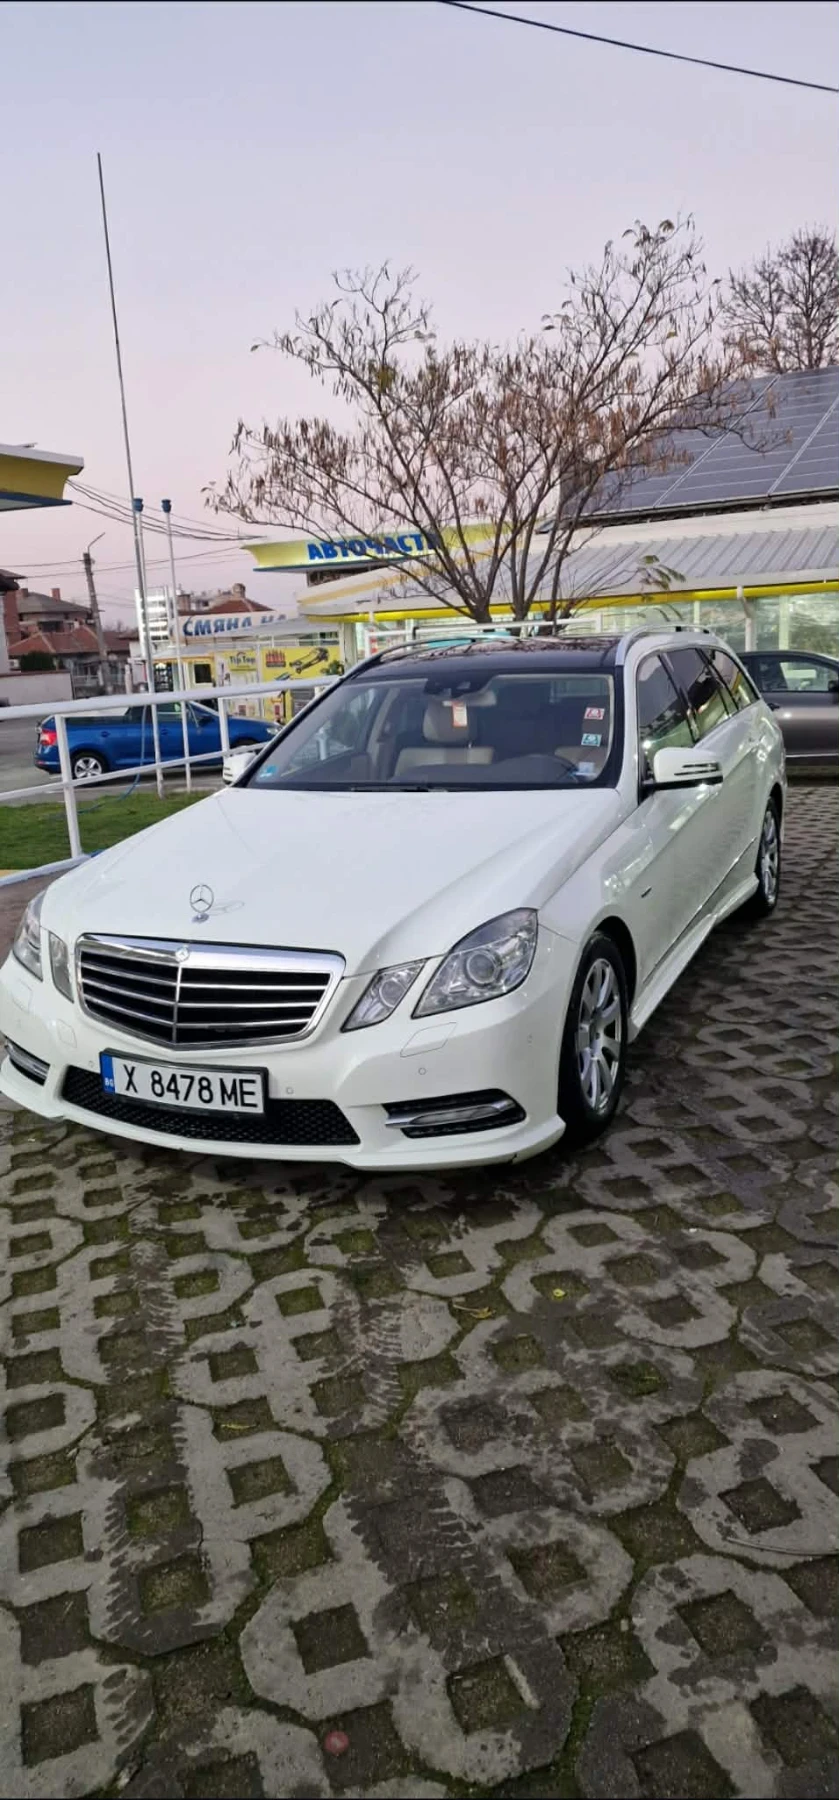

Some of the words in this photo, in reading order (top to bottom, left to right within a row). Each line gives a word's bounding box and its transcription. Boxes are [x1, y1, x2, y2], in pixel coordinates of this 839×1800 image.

[307, 533, 441, 560] АВТОЧАСТ
[123, 1064, 138, 1093] X
[151, 1070, 214, 1104] 8478
[219, 1077, 258, 1108] ME
